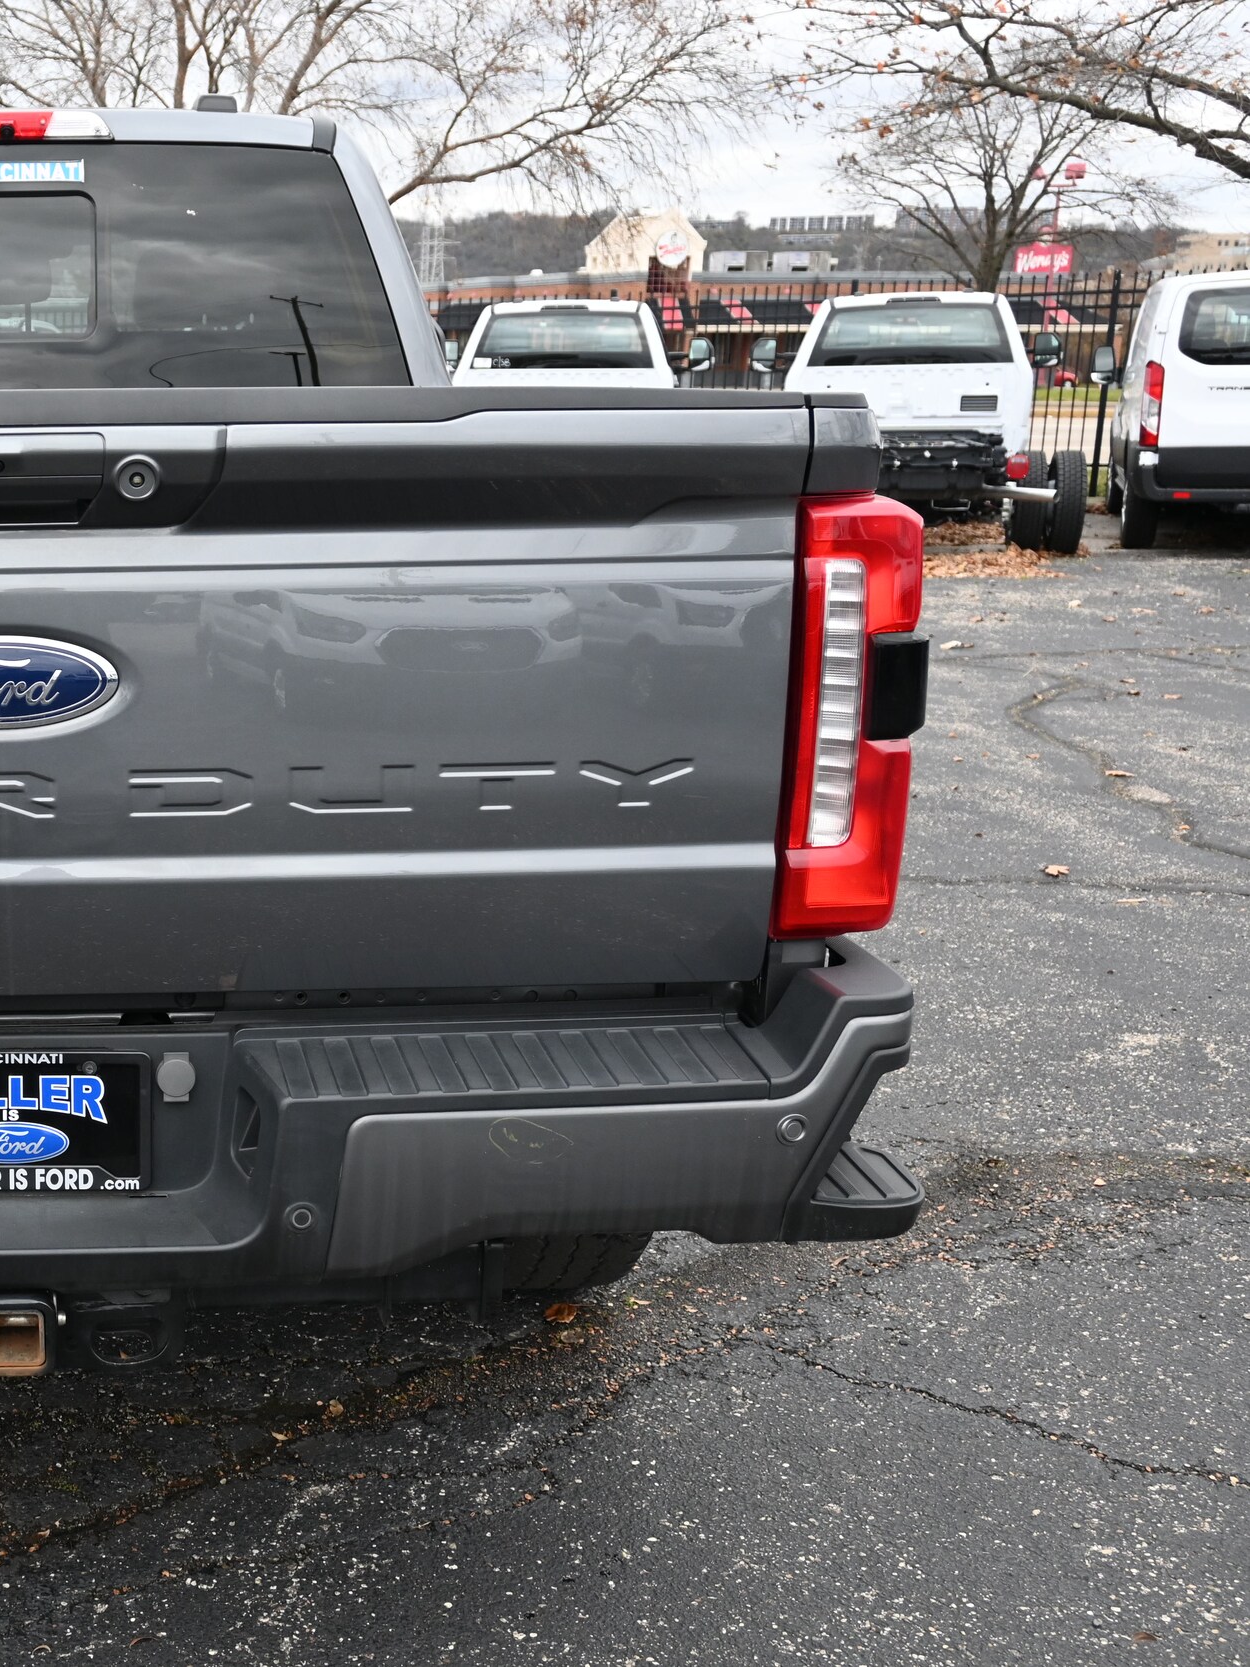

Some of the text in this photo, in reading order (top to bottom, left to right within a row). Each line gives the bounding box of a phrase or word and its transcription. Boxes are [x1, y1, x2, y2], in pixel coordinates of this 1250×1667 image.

[128, 758, 694, 817] DUTY
[2, 1109, 20, 1122] IS
[9, 1168, 28, 1191] IS
[34, 1168, 94, 1191] FORD
[99, 1178, 140, 1191] .com
